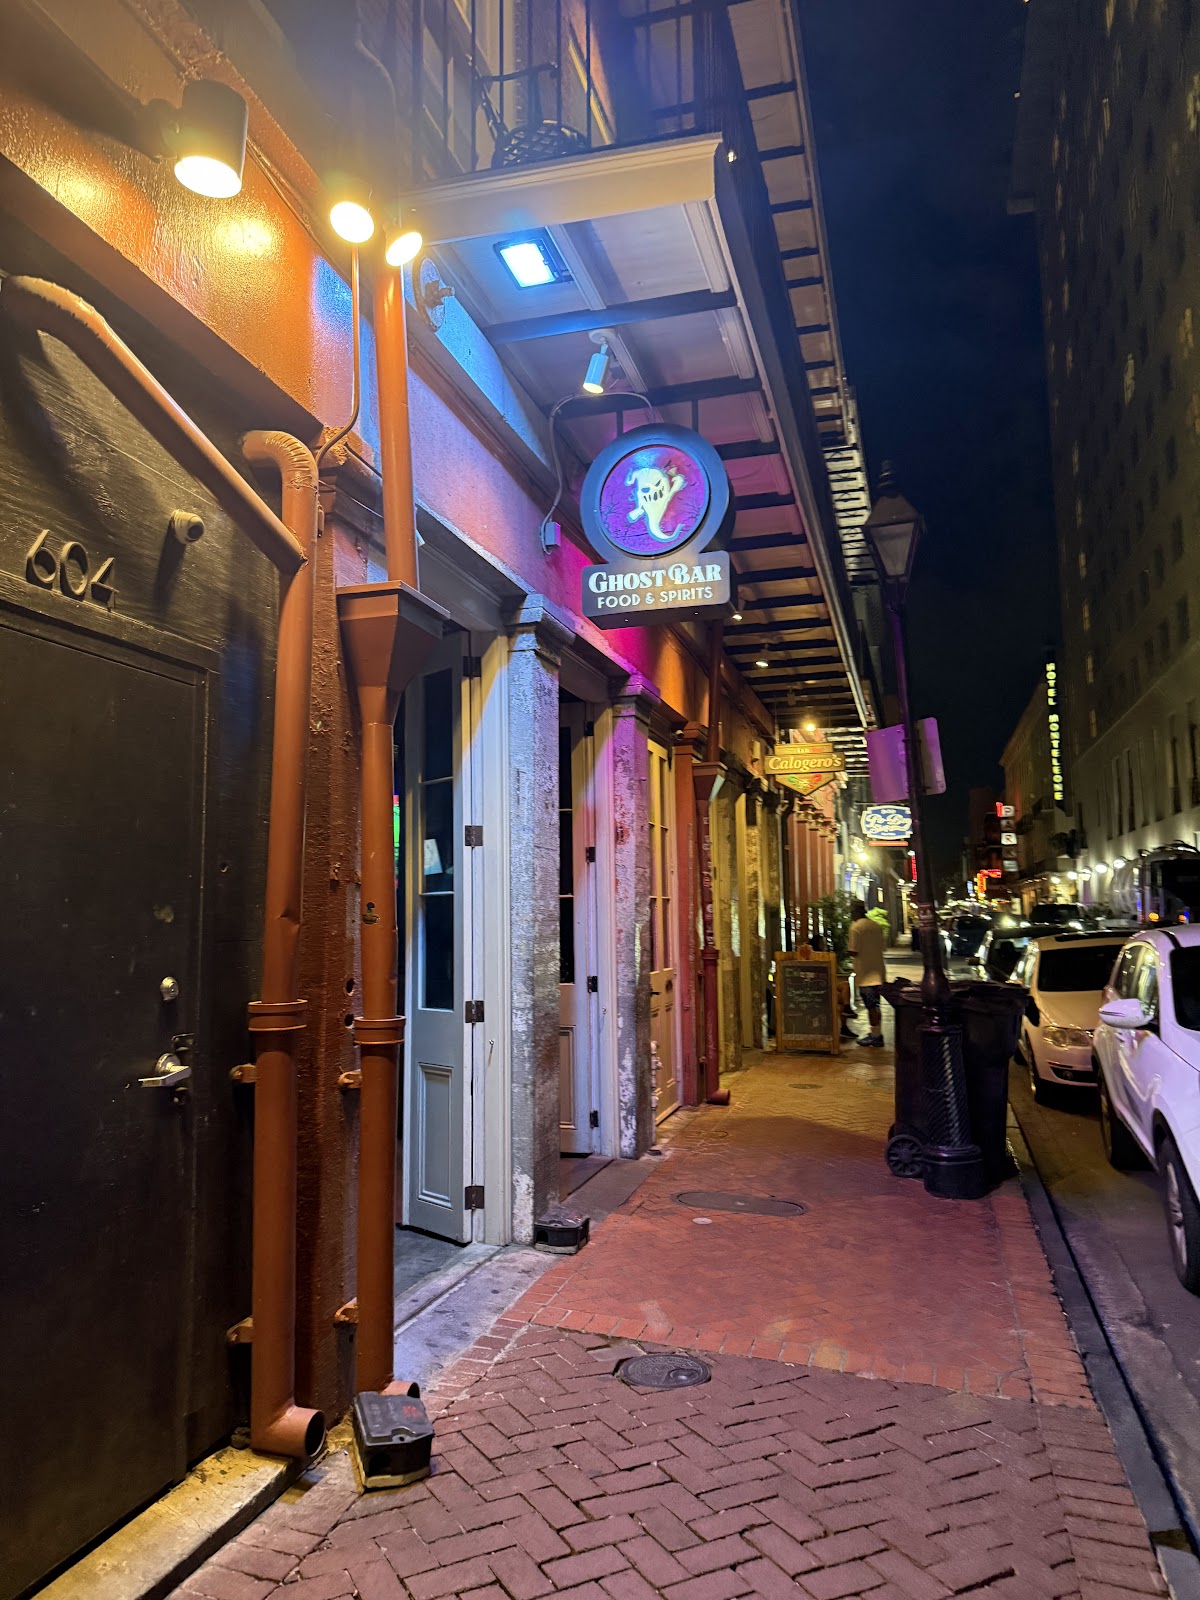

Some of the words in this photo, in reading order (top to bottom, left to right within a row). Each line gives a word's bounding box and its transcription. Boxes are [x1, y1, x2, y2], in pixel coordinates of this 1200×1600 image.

[25, 529, 120, 612] 604
[588, 569, 667, 594] GHOST
[668, 563, 722, 585] BAR
[597, 592, 641, 609] FOOD
[645, 590, 655, 605] &
[659, 586, 714, 603] SPIRITS
[1045, 662, 1057, 706] HOTEL
[768, 754, 842, 772] Calogero's
[1048, 713, 1064, 801] MONTELEONE
